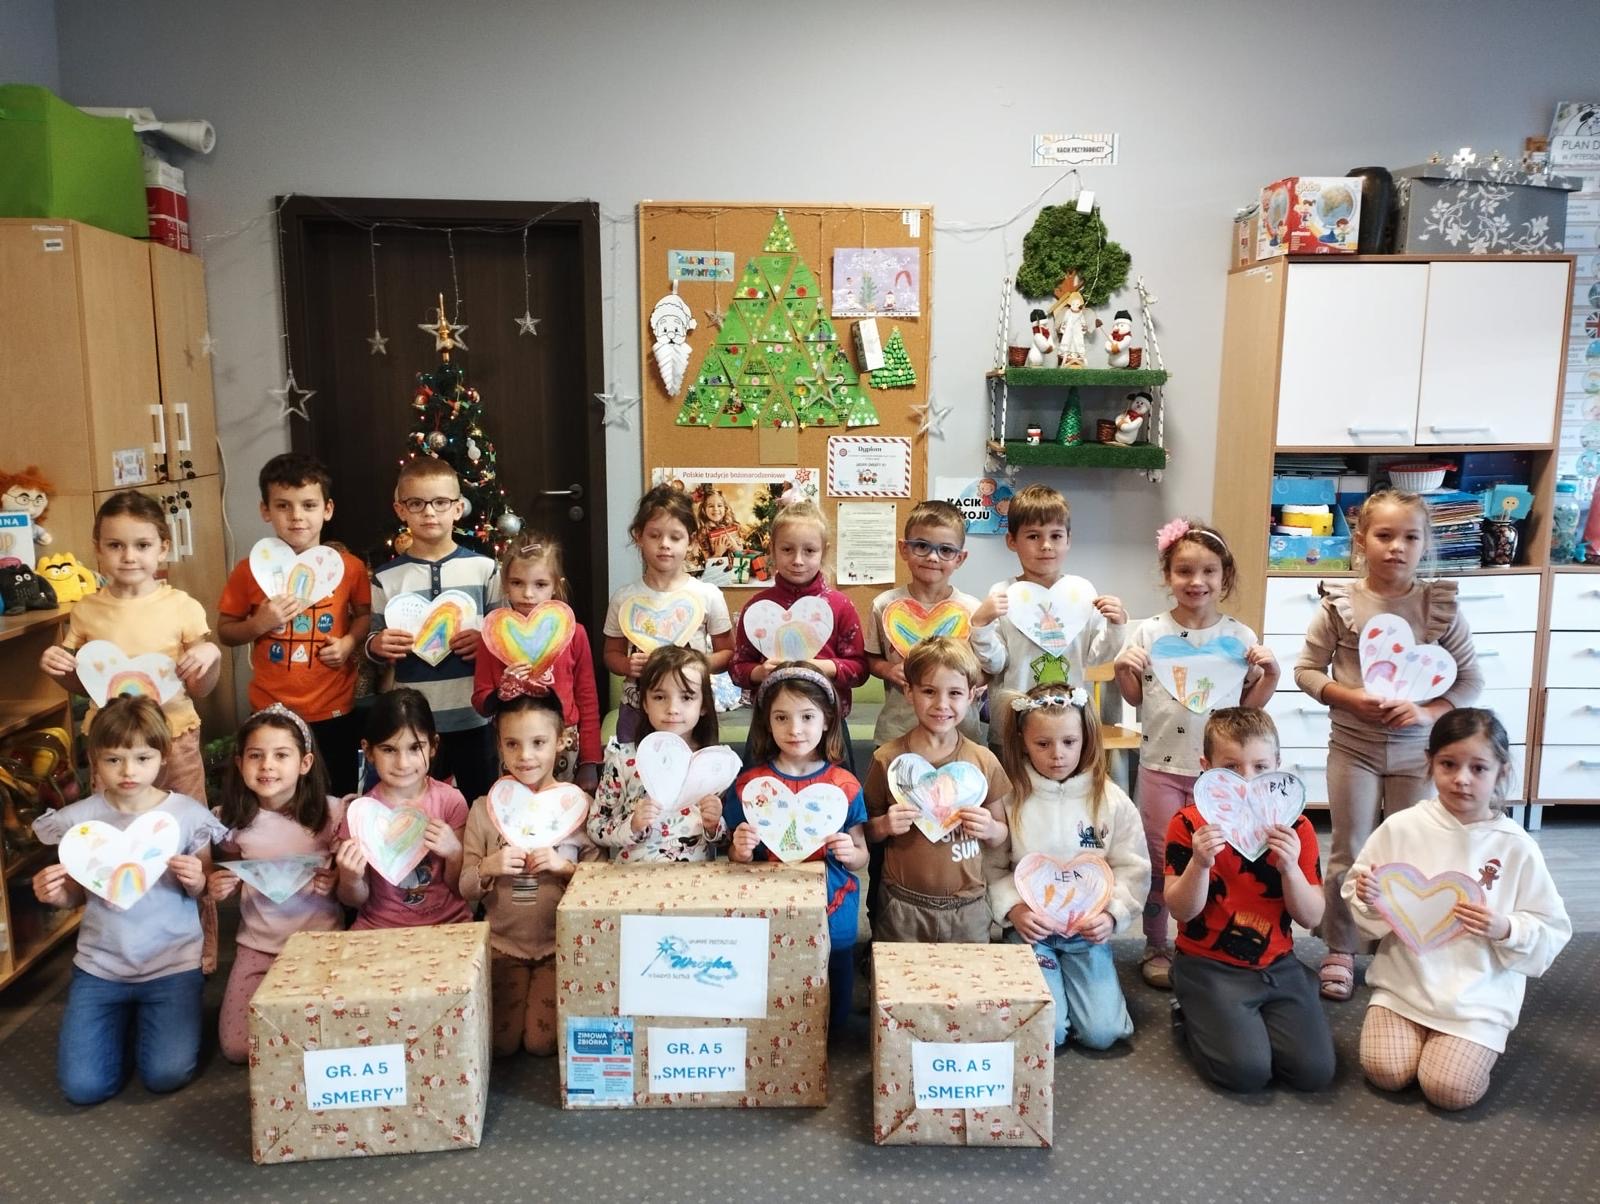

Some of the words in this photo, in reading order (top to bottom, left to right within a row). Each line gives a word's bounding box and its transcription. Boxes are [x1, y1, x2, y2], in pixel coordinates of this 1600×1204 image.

[1561, 140, 1590, 150] PLAN
[951, 840, 980, 862] SUN
[1054, 870, 1083, 883] LEA
[667, 1042, 695, 1055] GR.
[699, 1042, 710, 1054] A
[713, 1042, 723, 1054] 5
[325, 1064, 357, 1079] GR.
[362, 1062, 374, 1076] A
[378, 1062, 388, 1074] 5
[932, 1058, 962, 1073] GR.
[966, 1060, 977, 1072] A
[982, 1059, 991, 1071] 5
